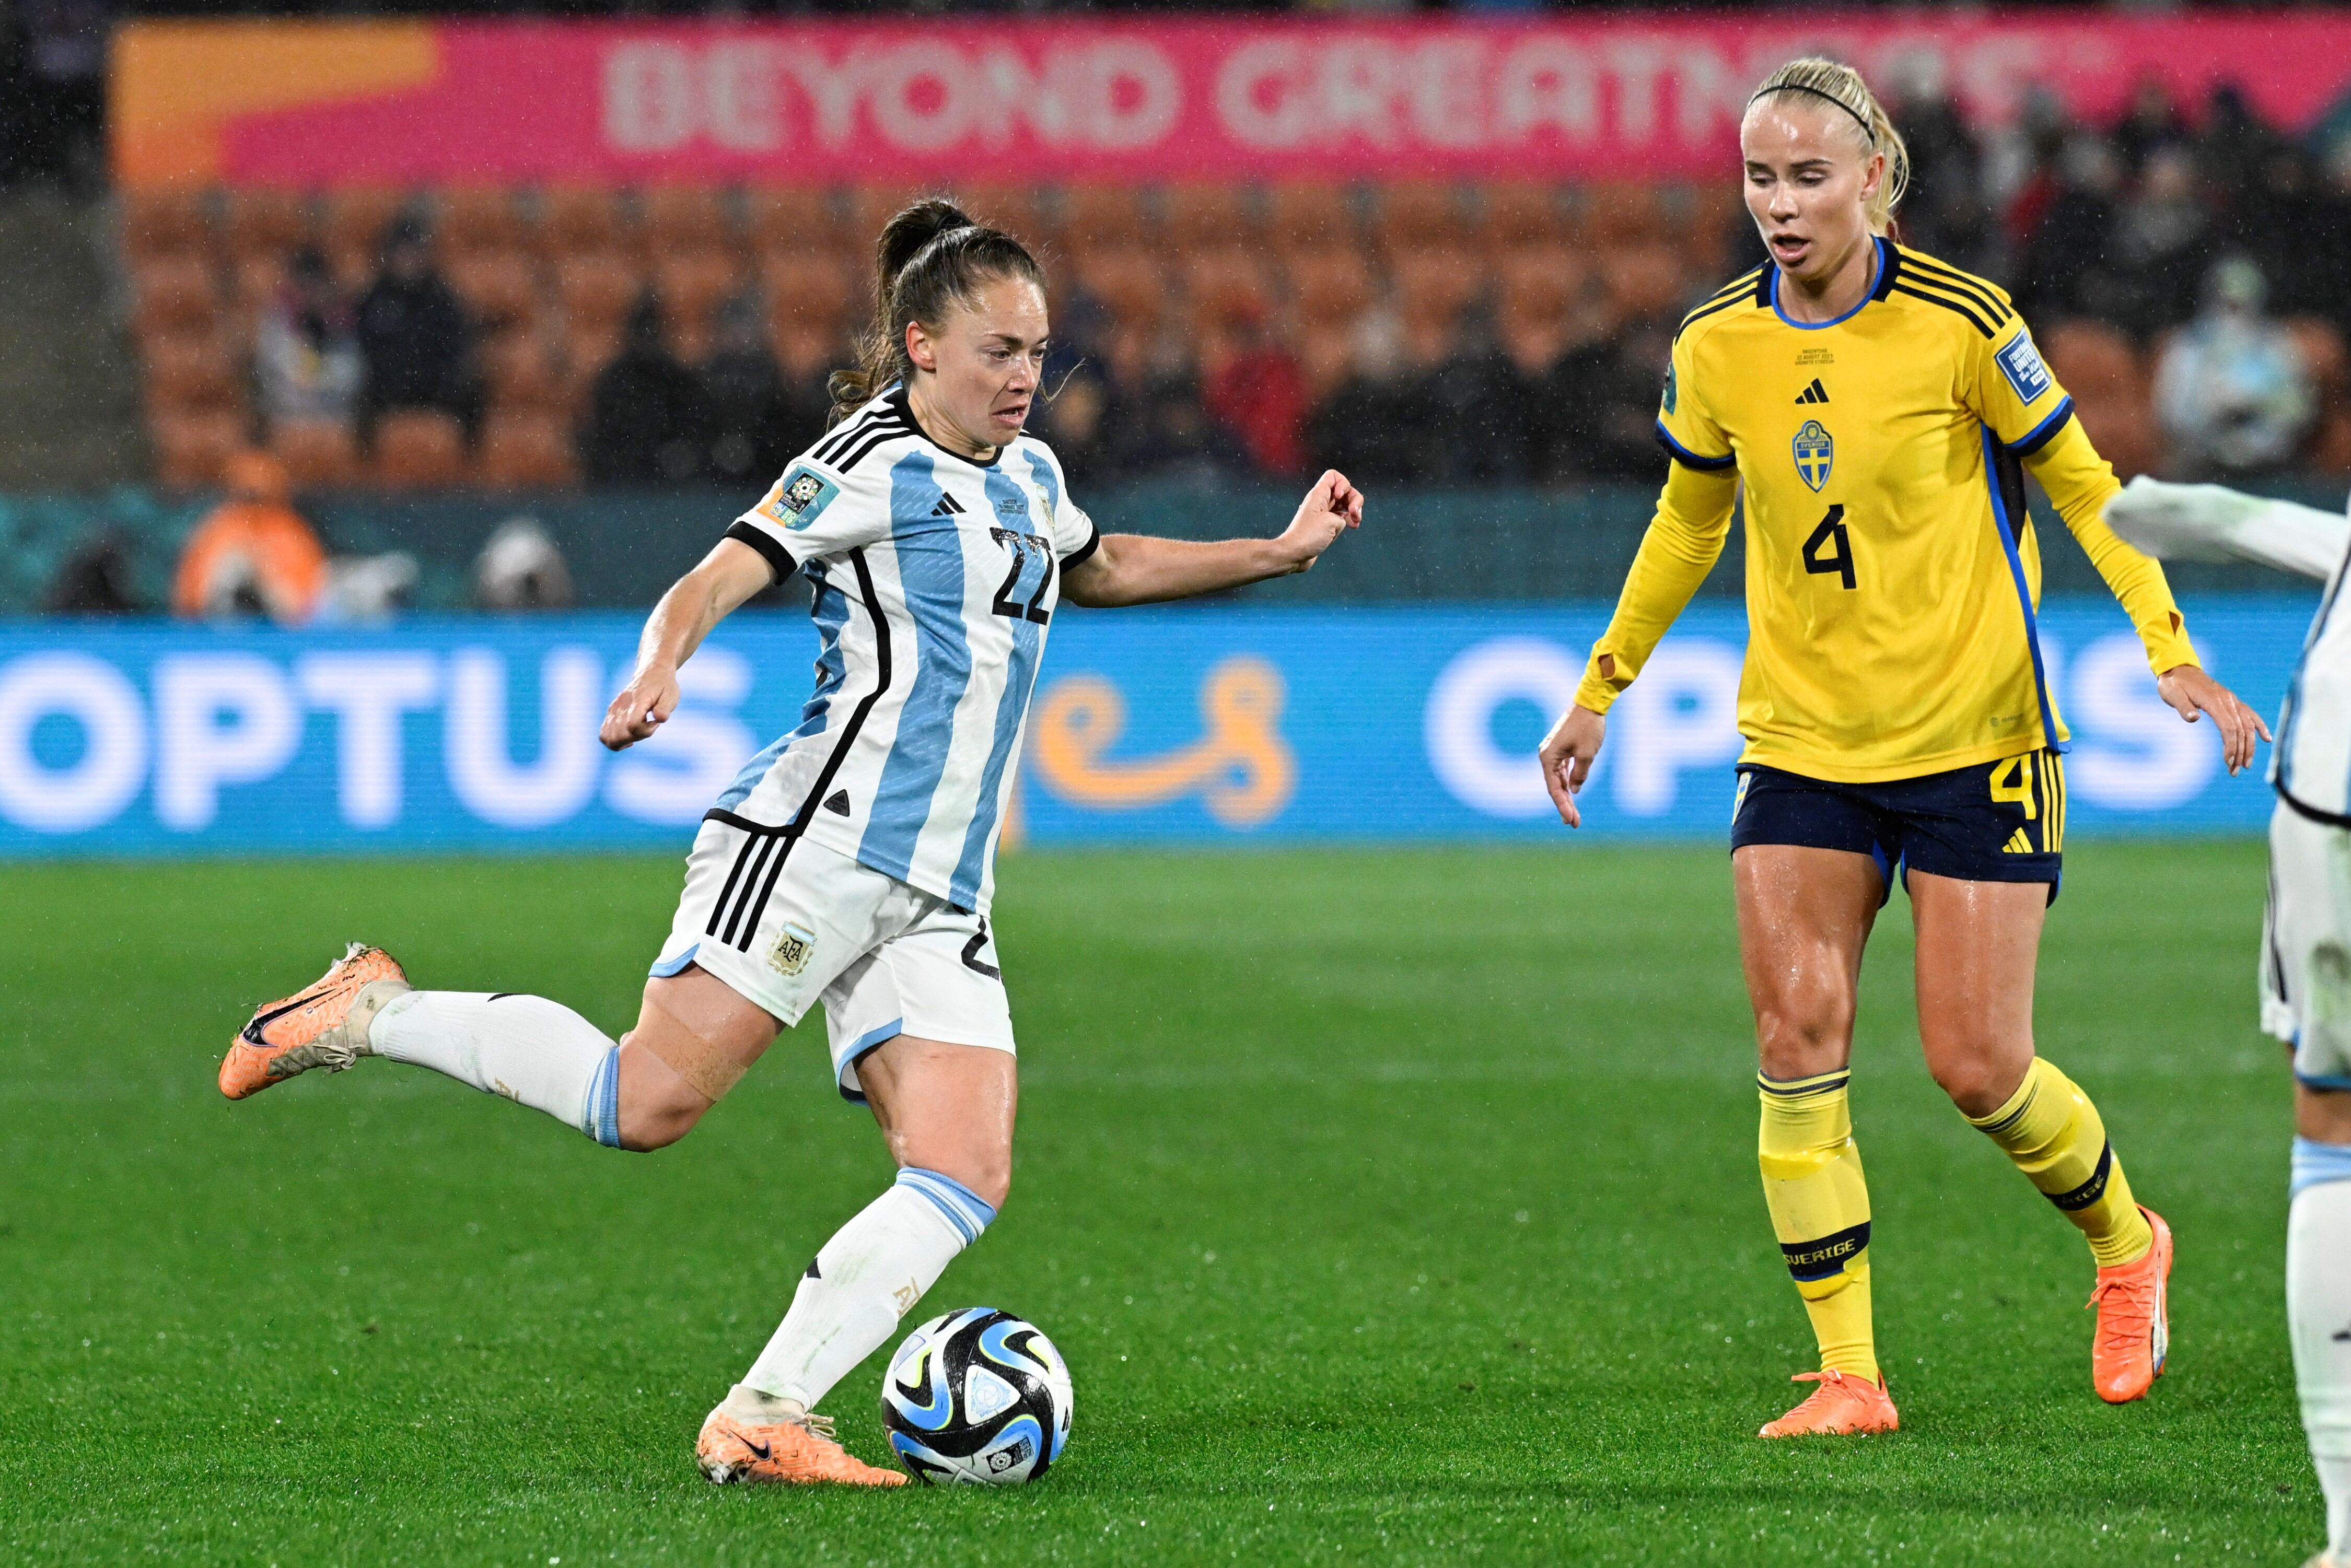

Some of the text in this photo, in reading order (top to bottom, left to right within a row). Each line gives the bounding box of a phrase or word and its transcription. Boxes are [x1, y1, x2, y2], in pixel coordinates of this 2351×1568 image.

[601, 34, 2040, 153] BEYOND GREATN
[990, 527, 1054, 625] 22
[1802, 504, 1856, 589] 4
[0, 647, 759, 830] OPTUS
[1989, 753, 2036, 820] 4
[778, 935, 804, 962] AFA
[1783, 1238, 1855, 1266] SVERIGE
